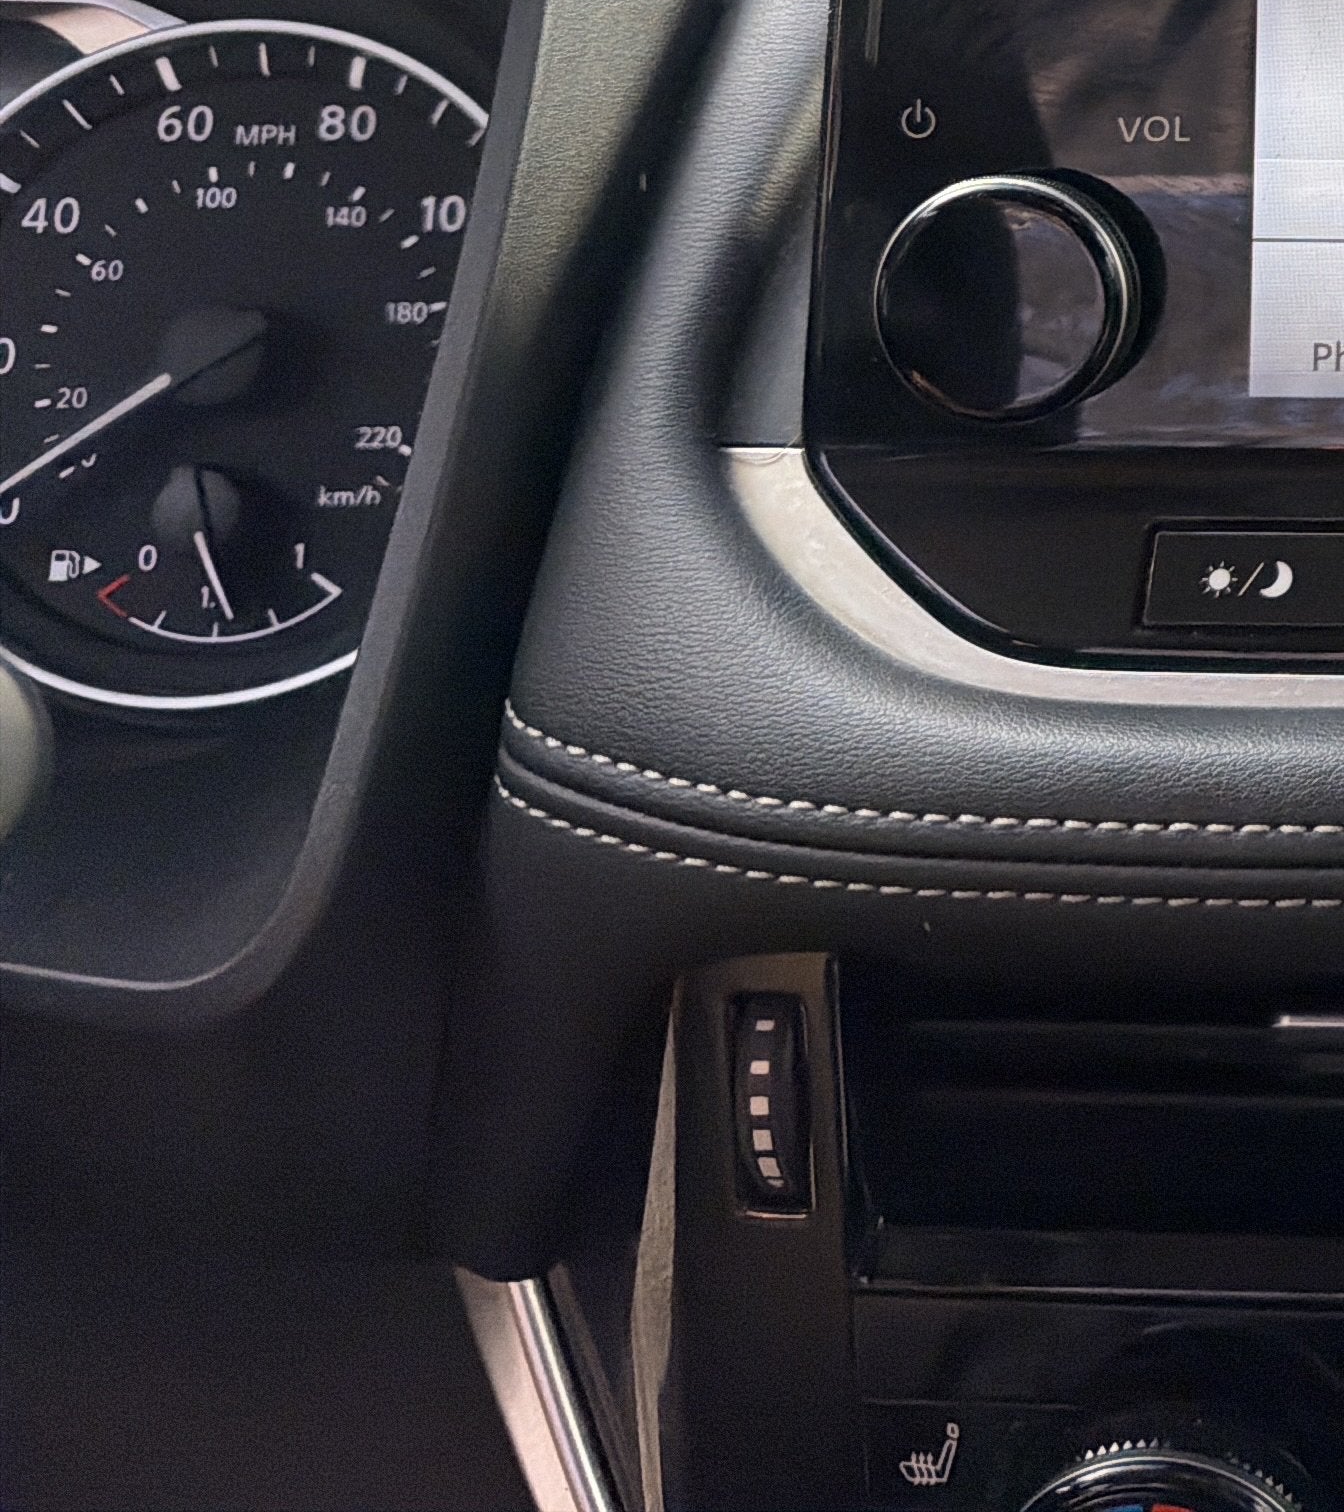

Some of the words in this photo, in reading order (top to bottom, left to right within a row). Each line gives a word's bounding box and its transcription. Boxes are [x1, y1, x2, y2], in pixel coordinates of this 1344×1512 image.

[157, 105, 214, 142] 60
[235, 124, 296, 146] MPH
[318, 105, 377, 142] 80
[1117, 116, 1191, 143] VOL
[196, 187, 237, 209] 100
[21, 196, 80, 235] 40
[325, 205, 367, 228] 140
[90, 260, 124, 282] 60
[386, 302, 429, 324] 180
[56, 387, 88, 409] 20
[354, 426, 403, 450] 220
[318, 485, 381, 507] km/h
[138, 544, 158, 571] 0
[294, 542, 305, 569] 1
